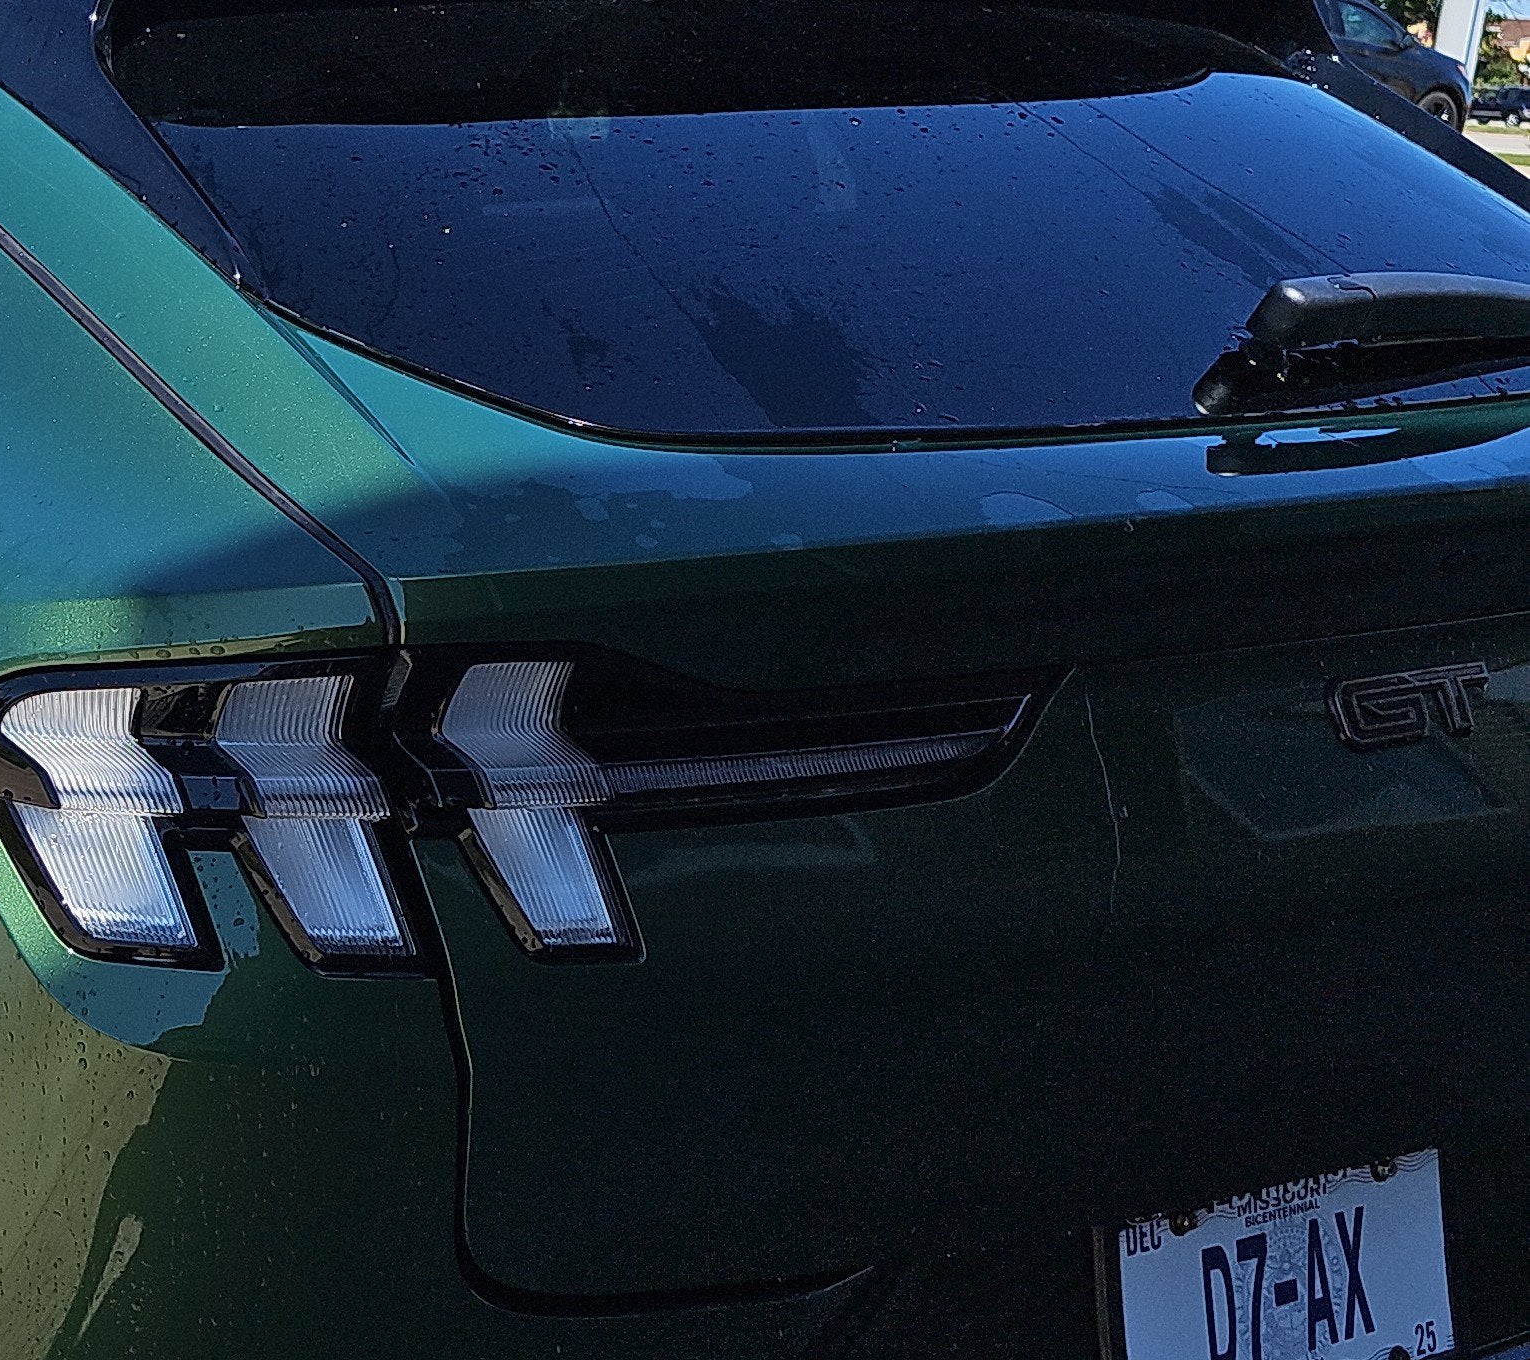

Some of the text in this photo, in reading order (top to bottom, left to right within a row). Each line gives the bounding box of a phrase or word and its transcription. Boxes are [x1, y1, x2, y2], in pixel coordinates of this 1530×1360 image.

[1332, 661, 1490, 744] GT
[1244, 1198, 1320, 1228] BICENTENNIAL
[1125, 1223, 1163, 1257] DEC
[1414, 1321, 1438, 1357] 25
